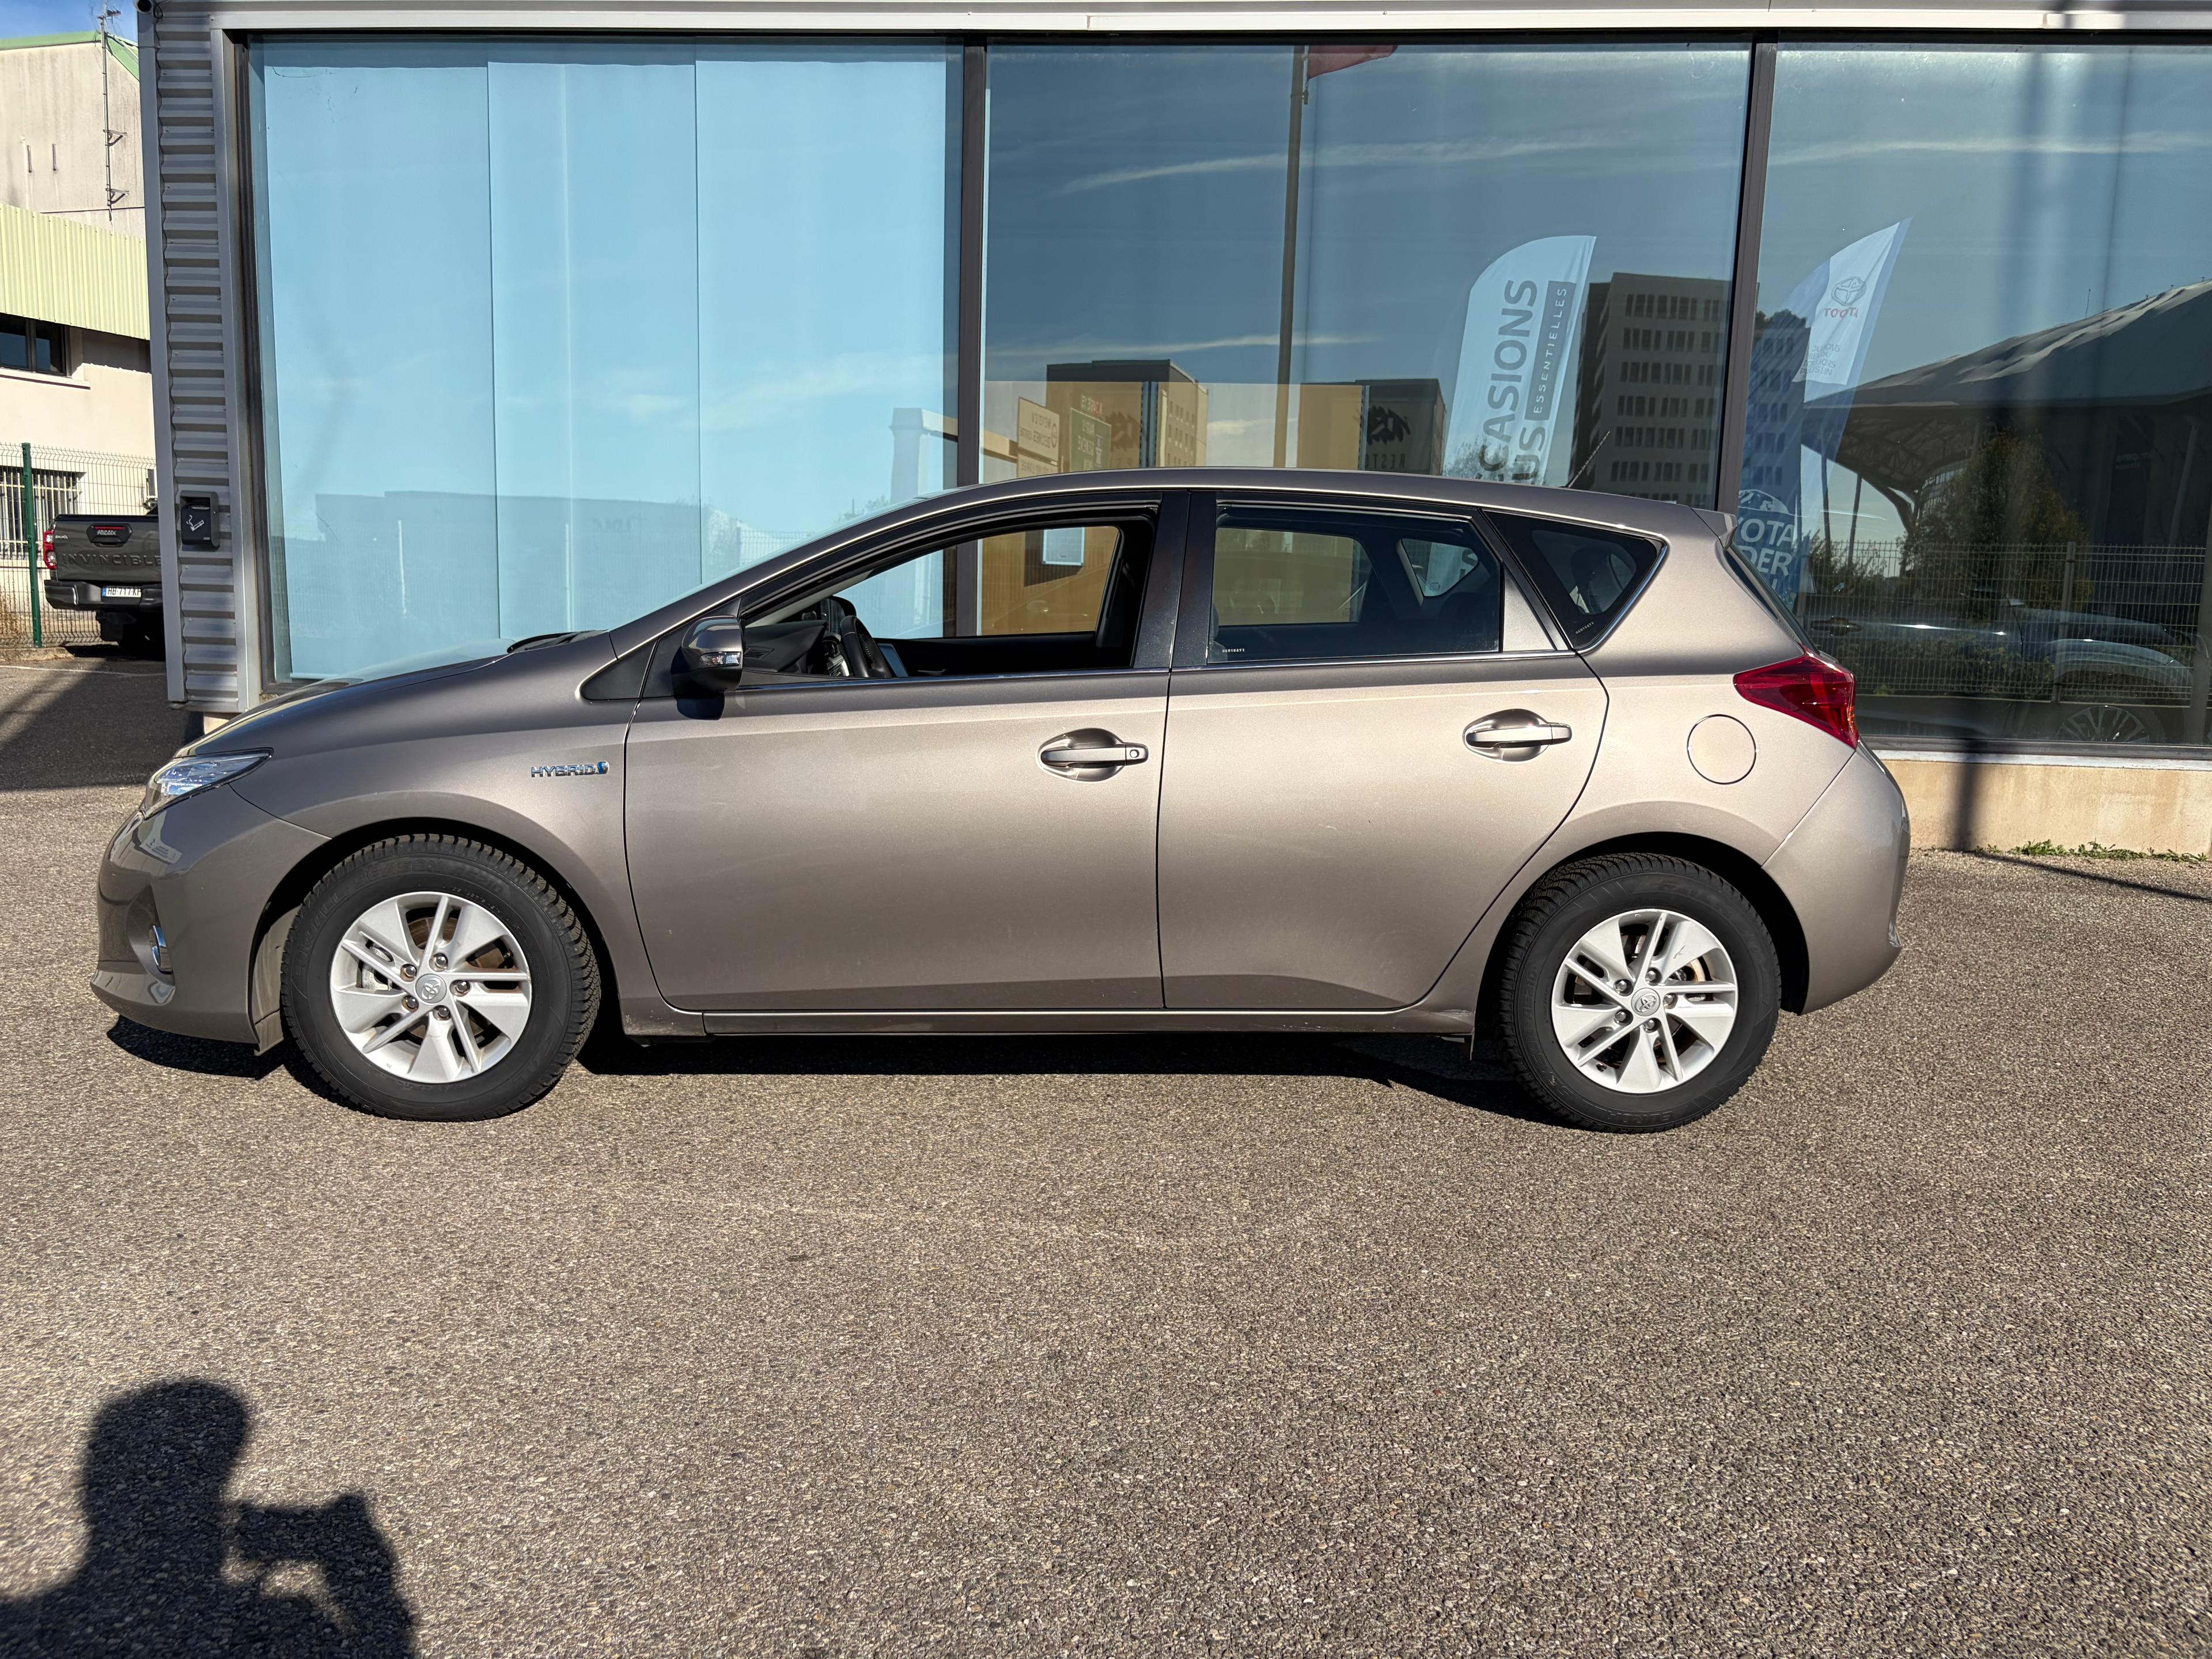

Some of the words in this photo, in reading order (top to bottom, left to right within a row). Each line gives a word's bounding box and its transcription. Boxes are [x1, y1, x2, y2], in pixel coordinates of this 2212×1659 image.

[1824, 308, 1858, 318] TOOTA
[1533, 288, 1567, 414] ESSENTIELLES
[1475, 279, 1537, 481] CASIONS
[1738, 517, 1794, 548] OTA
[62, 553, 161, 566] INVINCIBLE
[531, 763, 596, 778] HYBRID
[354, 860, 446, 888] SEASON
